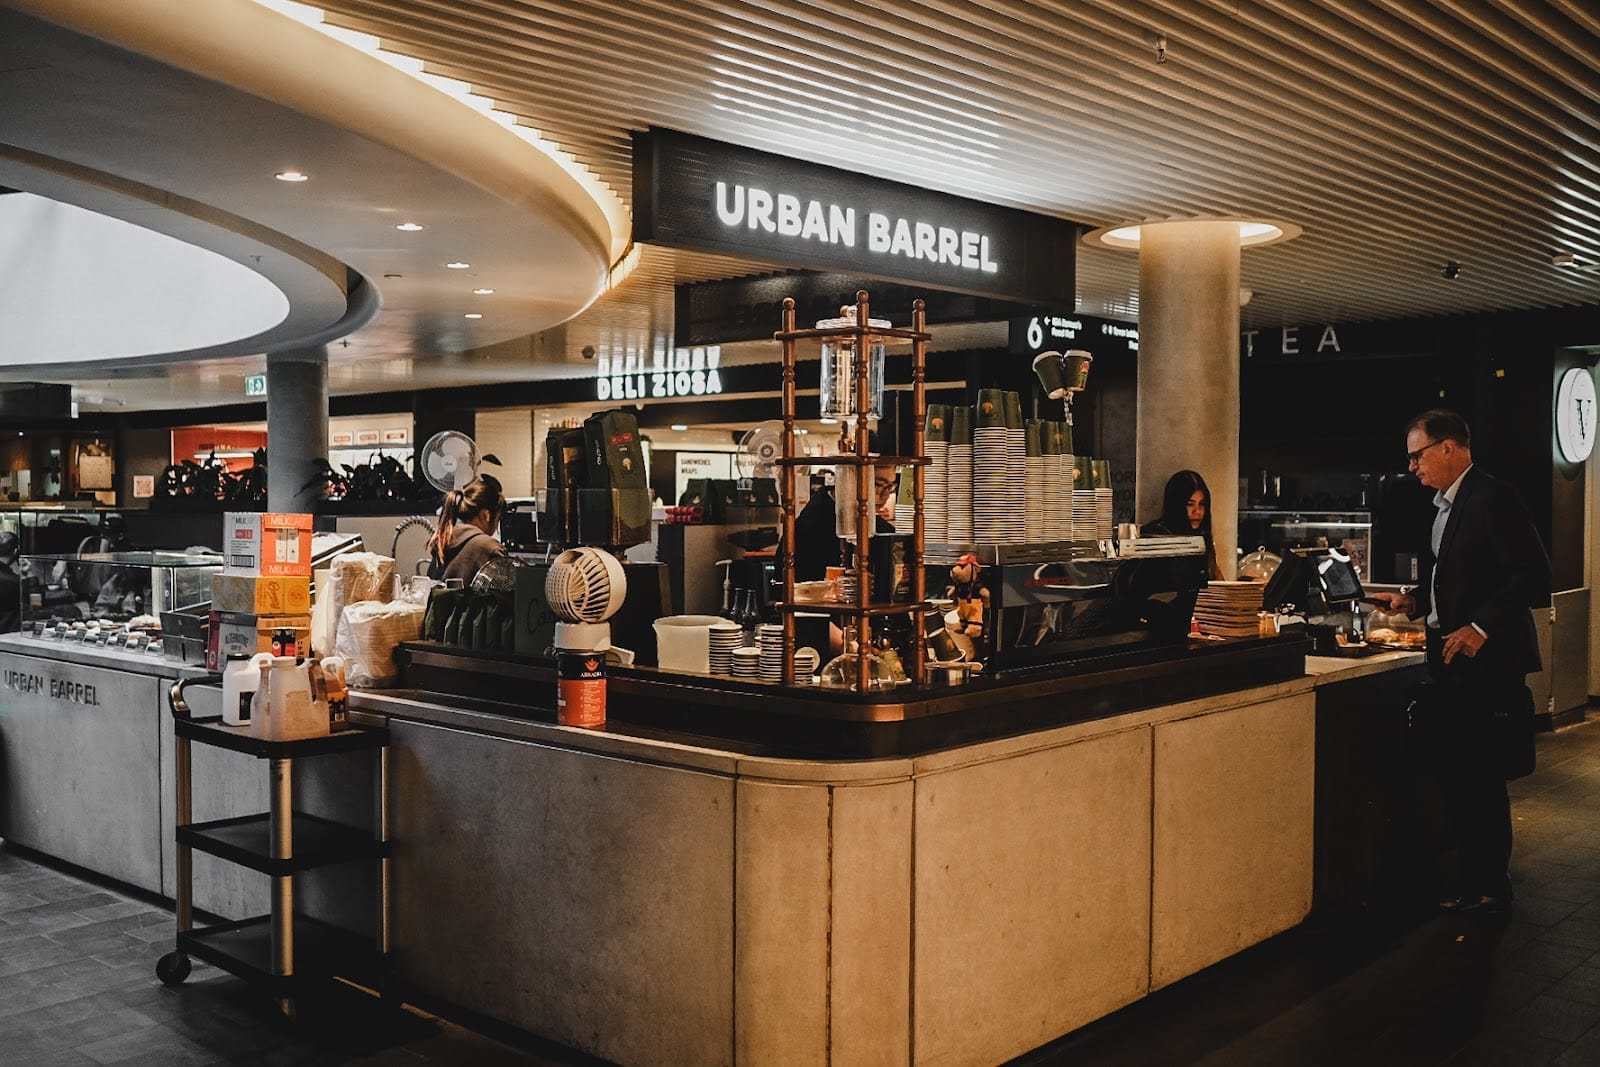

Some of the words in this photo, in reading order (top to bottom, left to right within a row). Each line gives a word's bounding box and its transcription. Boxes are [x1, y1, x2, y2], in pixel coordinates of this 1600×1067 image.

[716, 181, 855, 247] URBAN
[868, 212, 998, 273] BARREL
[1027, 316, 1043, 349] 6
[597, 375, 646, 400] DELI
[652, 370, 722, 397] ZIOSA
[4, 669, 44, 697] URBAN
[50, 678, 101, 706] BARREL
